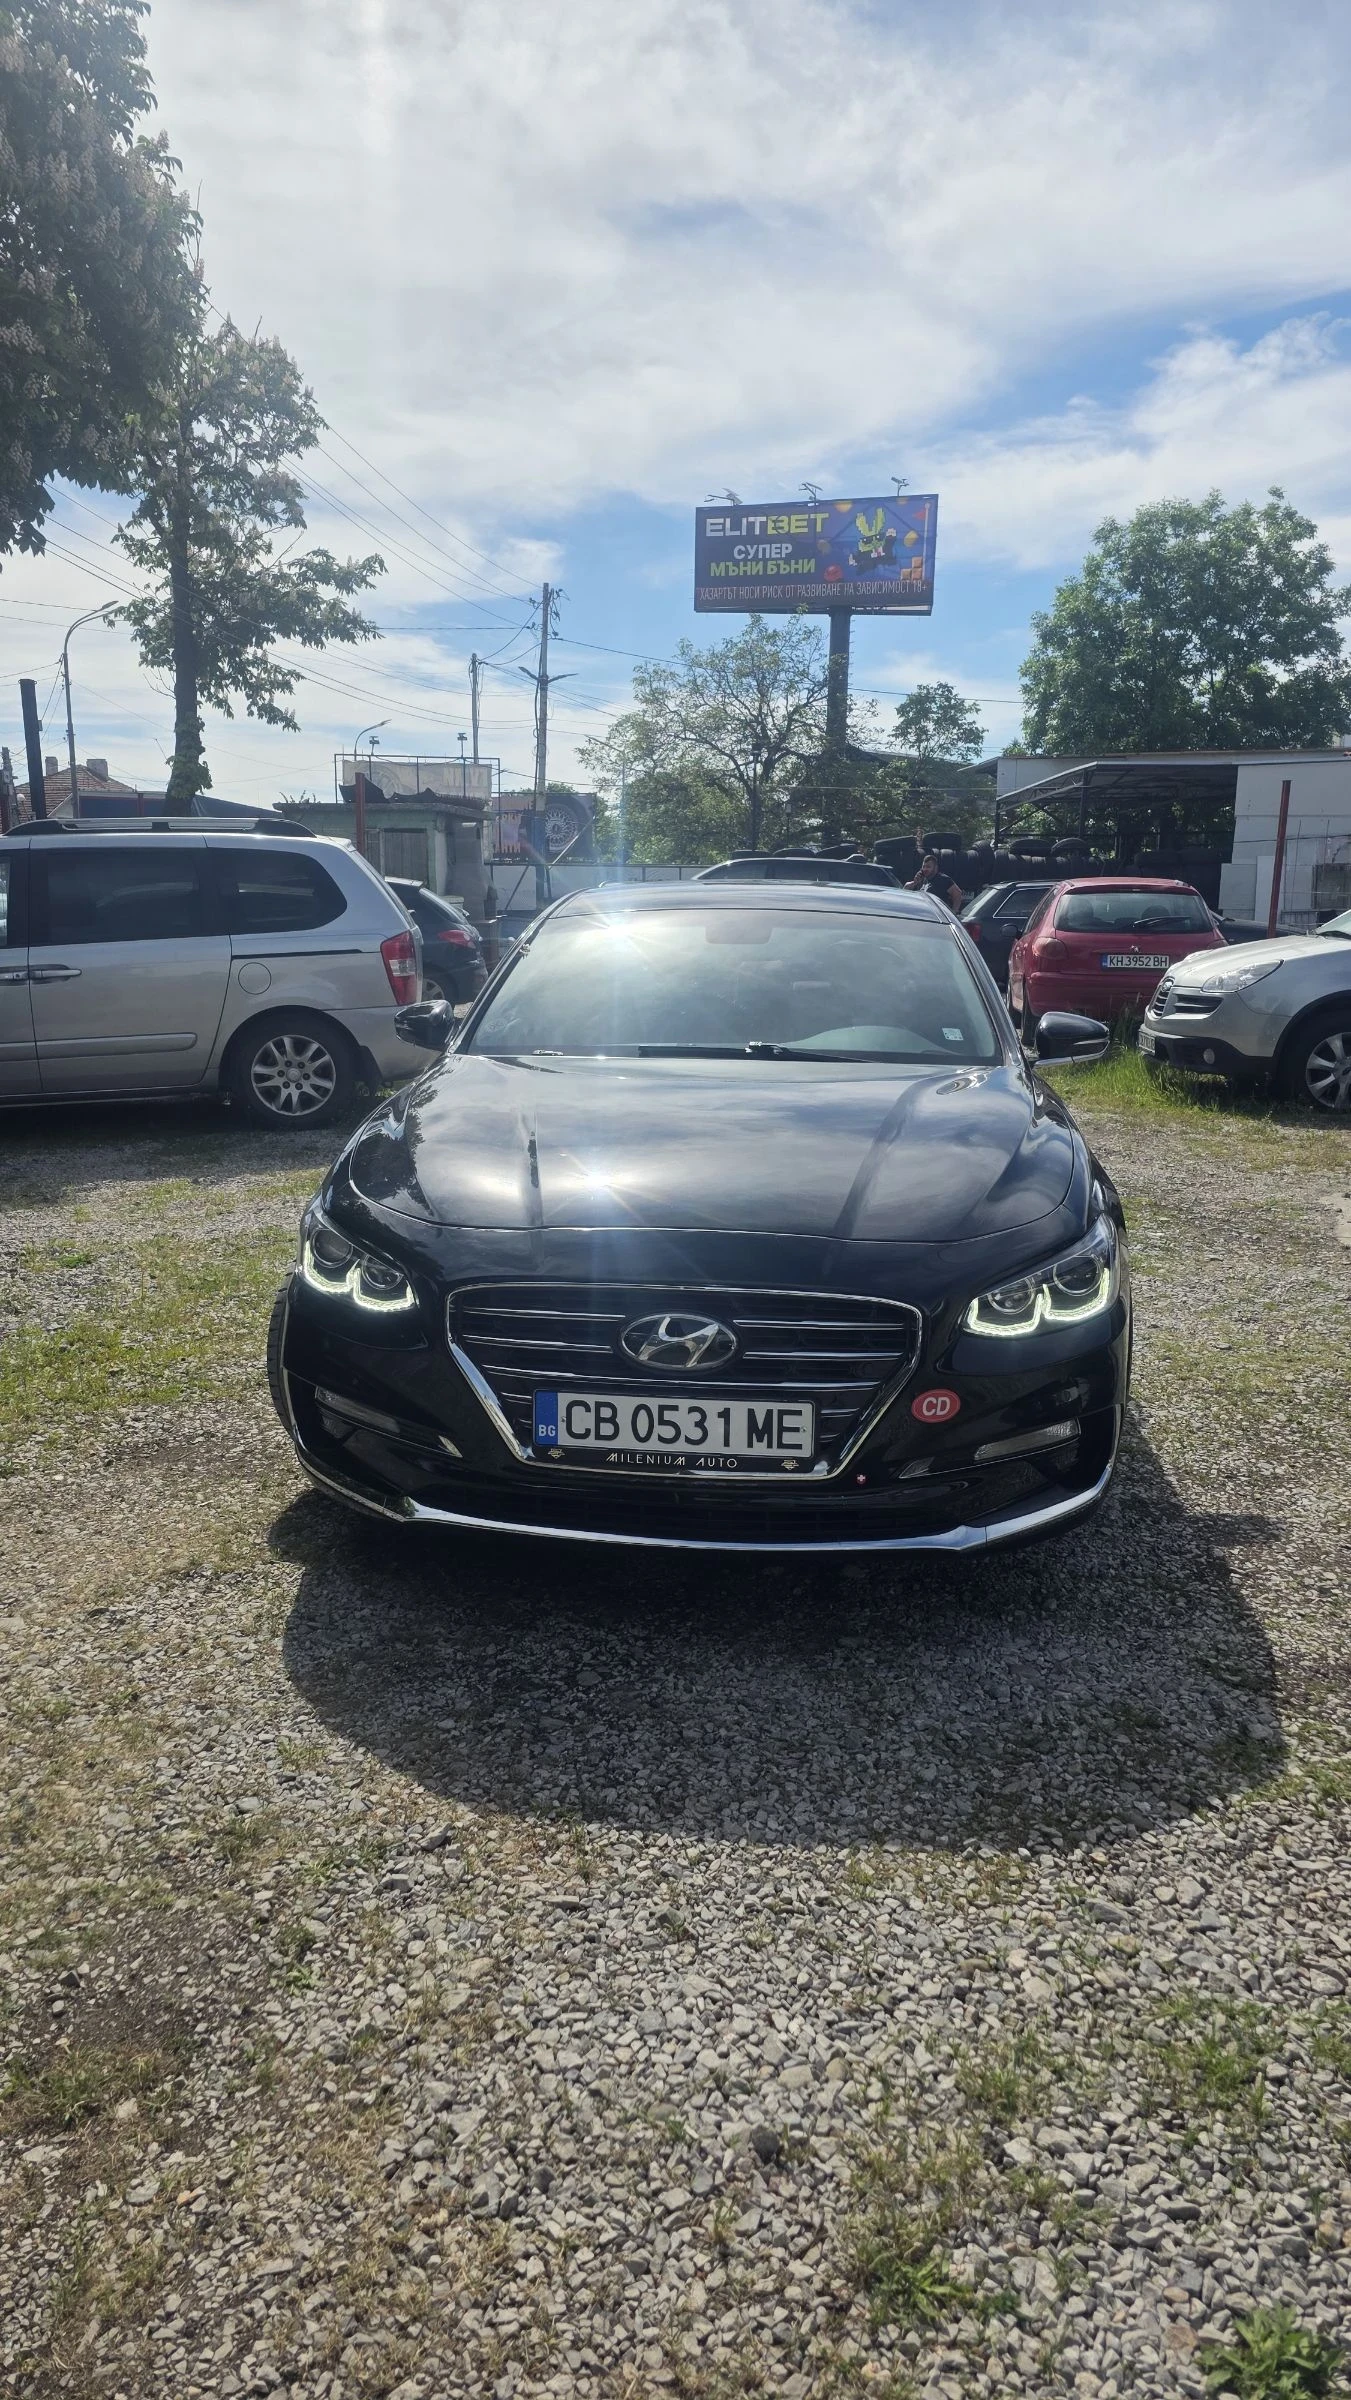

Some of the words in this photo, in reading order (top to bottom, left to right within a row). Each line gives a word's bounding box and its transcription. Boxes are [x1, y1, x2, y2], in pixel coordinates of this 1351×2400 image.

[733, 543, 793, 560] СУПЕР
[710, 561, 763, 577] МЪНИ
[766, 558, 815, 575] БЪНИ
[699, 586, 737, 600] ХАЗАРТЪТ
[740, 586, 760, 599] НОСИ
[762, 584, 783, 598] РИСК
[785, 584, 795, 598] ОТ
[797, 582, 841, 597] РАЗВИВАНЕ
[844, 582, 855, 596] НА
[856, 579, 911, 595] ЗАВИСИМОСТ
[913, 580, 928, 593] 18+
[1109, 955, 1124, 967] KH
[1125, 956, 1151, 967] 3952
[1153, 956, 1168, 967] BH
[922, 1396, 951, 1416] CD
[538, 1424, 556, 1437] BG
[565, 1399, 620, 1442] CB
[631, 1403, 731, 1448] 0531
[747, 1407, 803, 1451] ME
[606, 1452, 686, 1466] MILENIUM
[695, 1456, 738, 1469] AUTO
